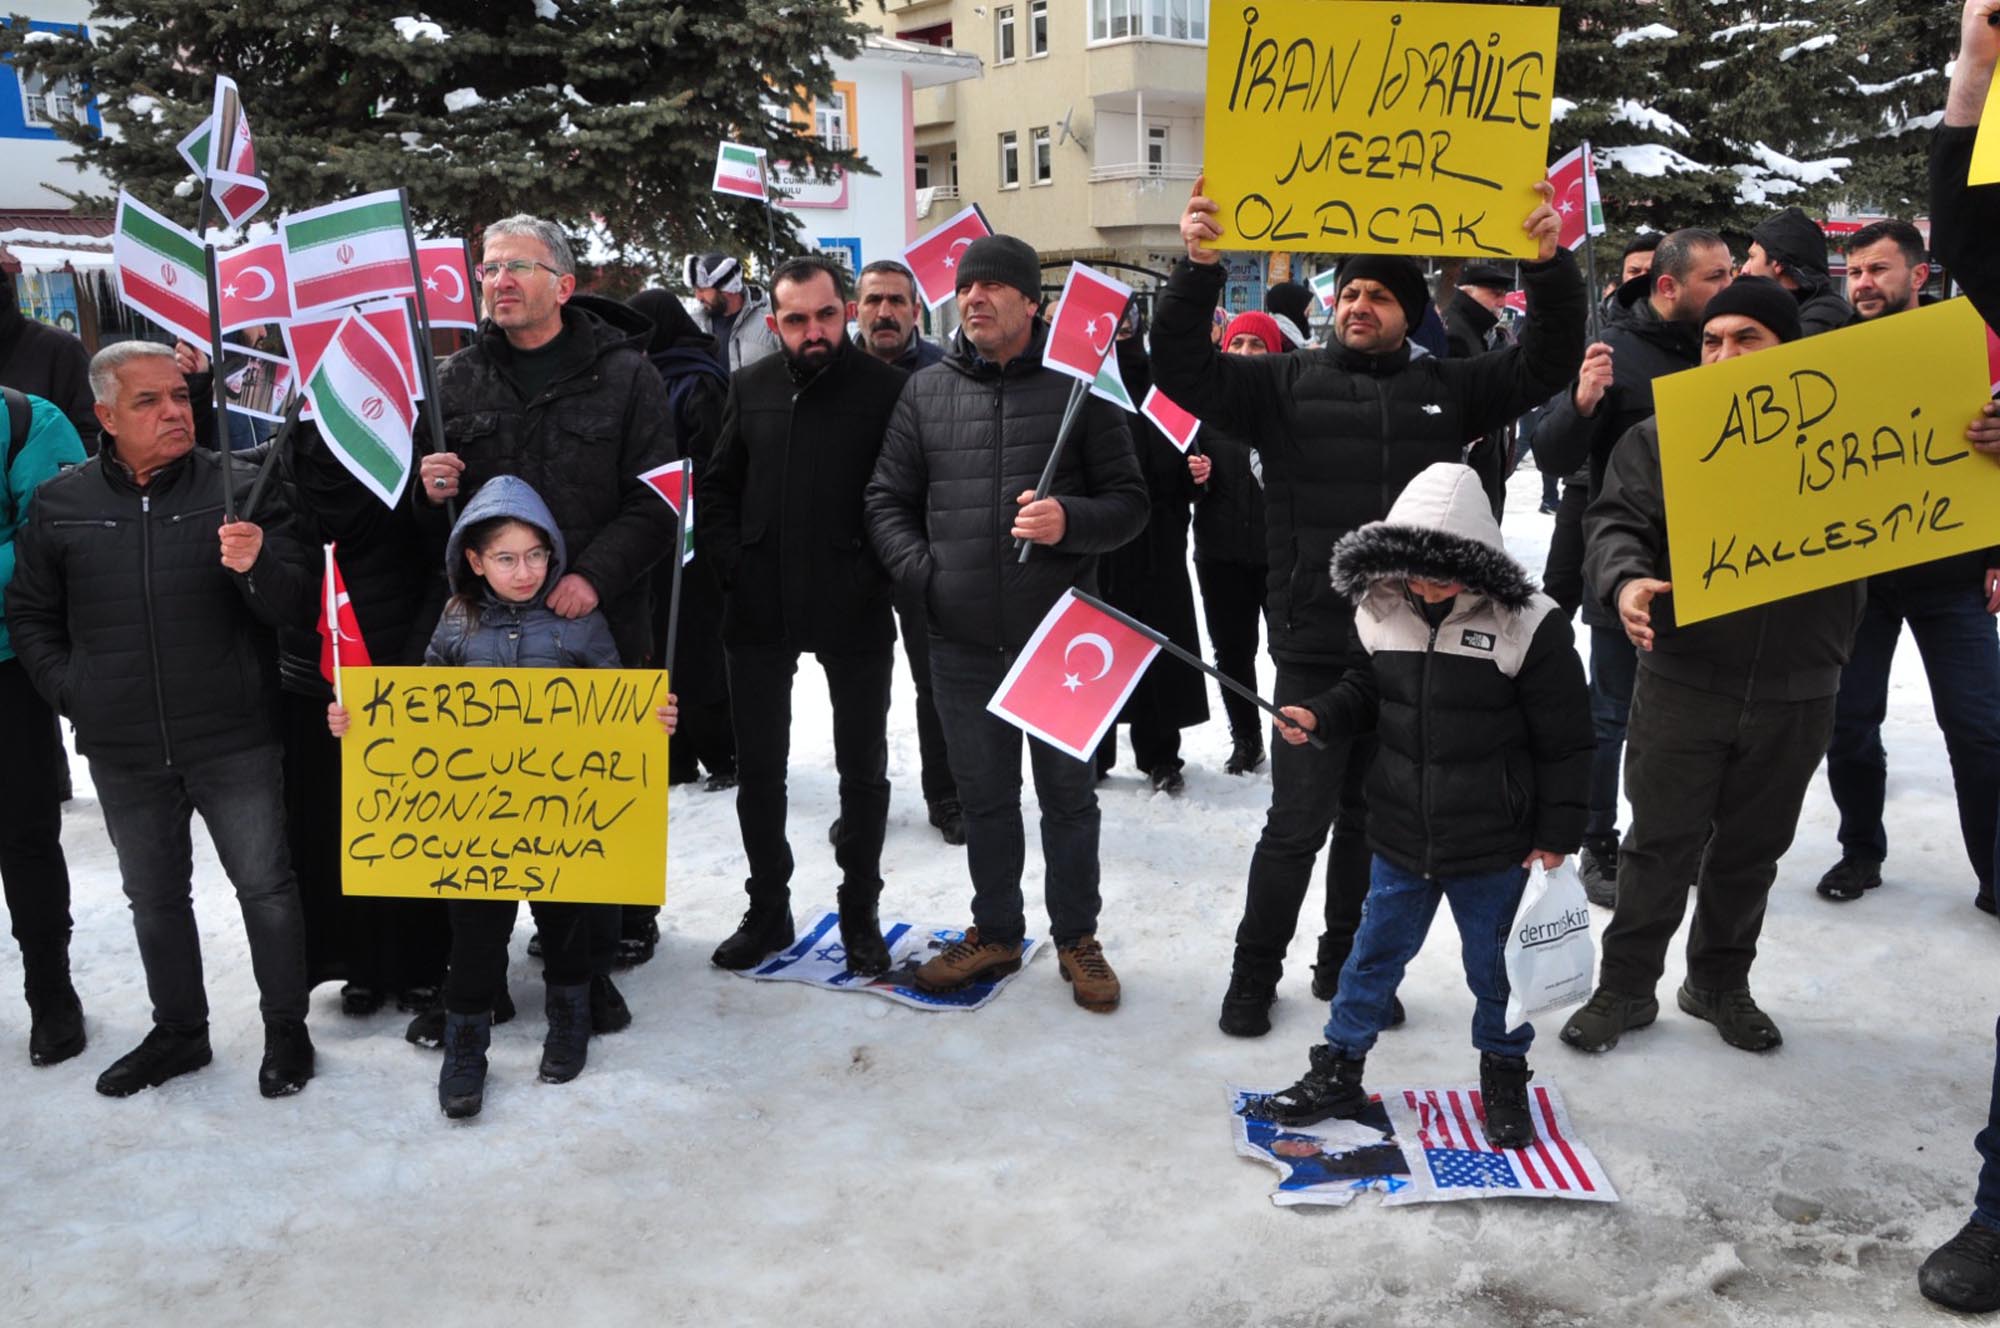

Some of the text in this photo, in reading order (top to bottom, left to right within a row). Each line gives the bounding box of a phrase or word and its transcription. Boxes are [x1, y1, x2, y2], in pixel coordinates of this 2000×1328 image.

[1228, 3, 1544, 130] İRAN İSRAİLE
[1274, 128, 1503, 191] MEZAR
[1234, 192, 1512, 256] OLACAK
[1699, 369, 1838, 463] ABD
[1795, 407, 1970, 495] İSRAİL
[1702, 489, 1964, 590] KALLEŞTİR
[362, 672, 663, 727] KERBALANIN
[362, 737, 648, 788] ÇOCUKLARI
[356, 780, 638, 831] SİYONİZMİN
[429, 864, 561, 897] KARŞI
